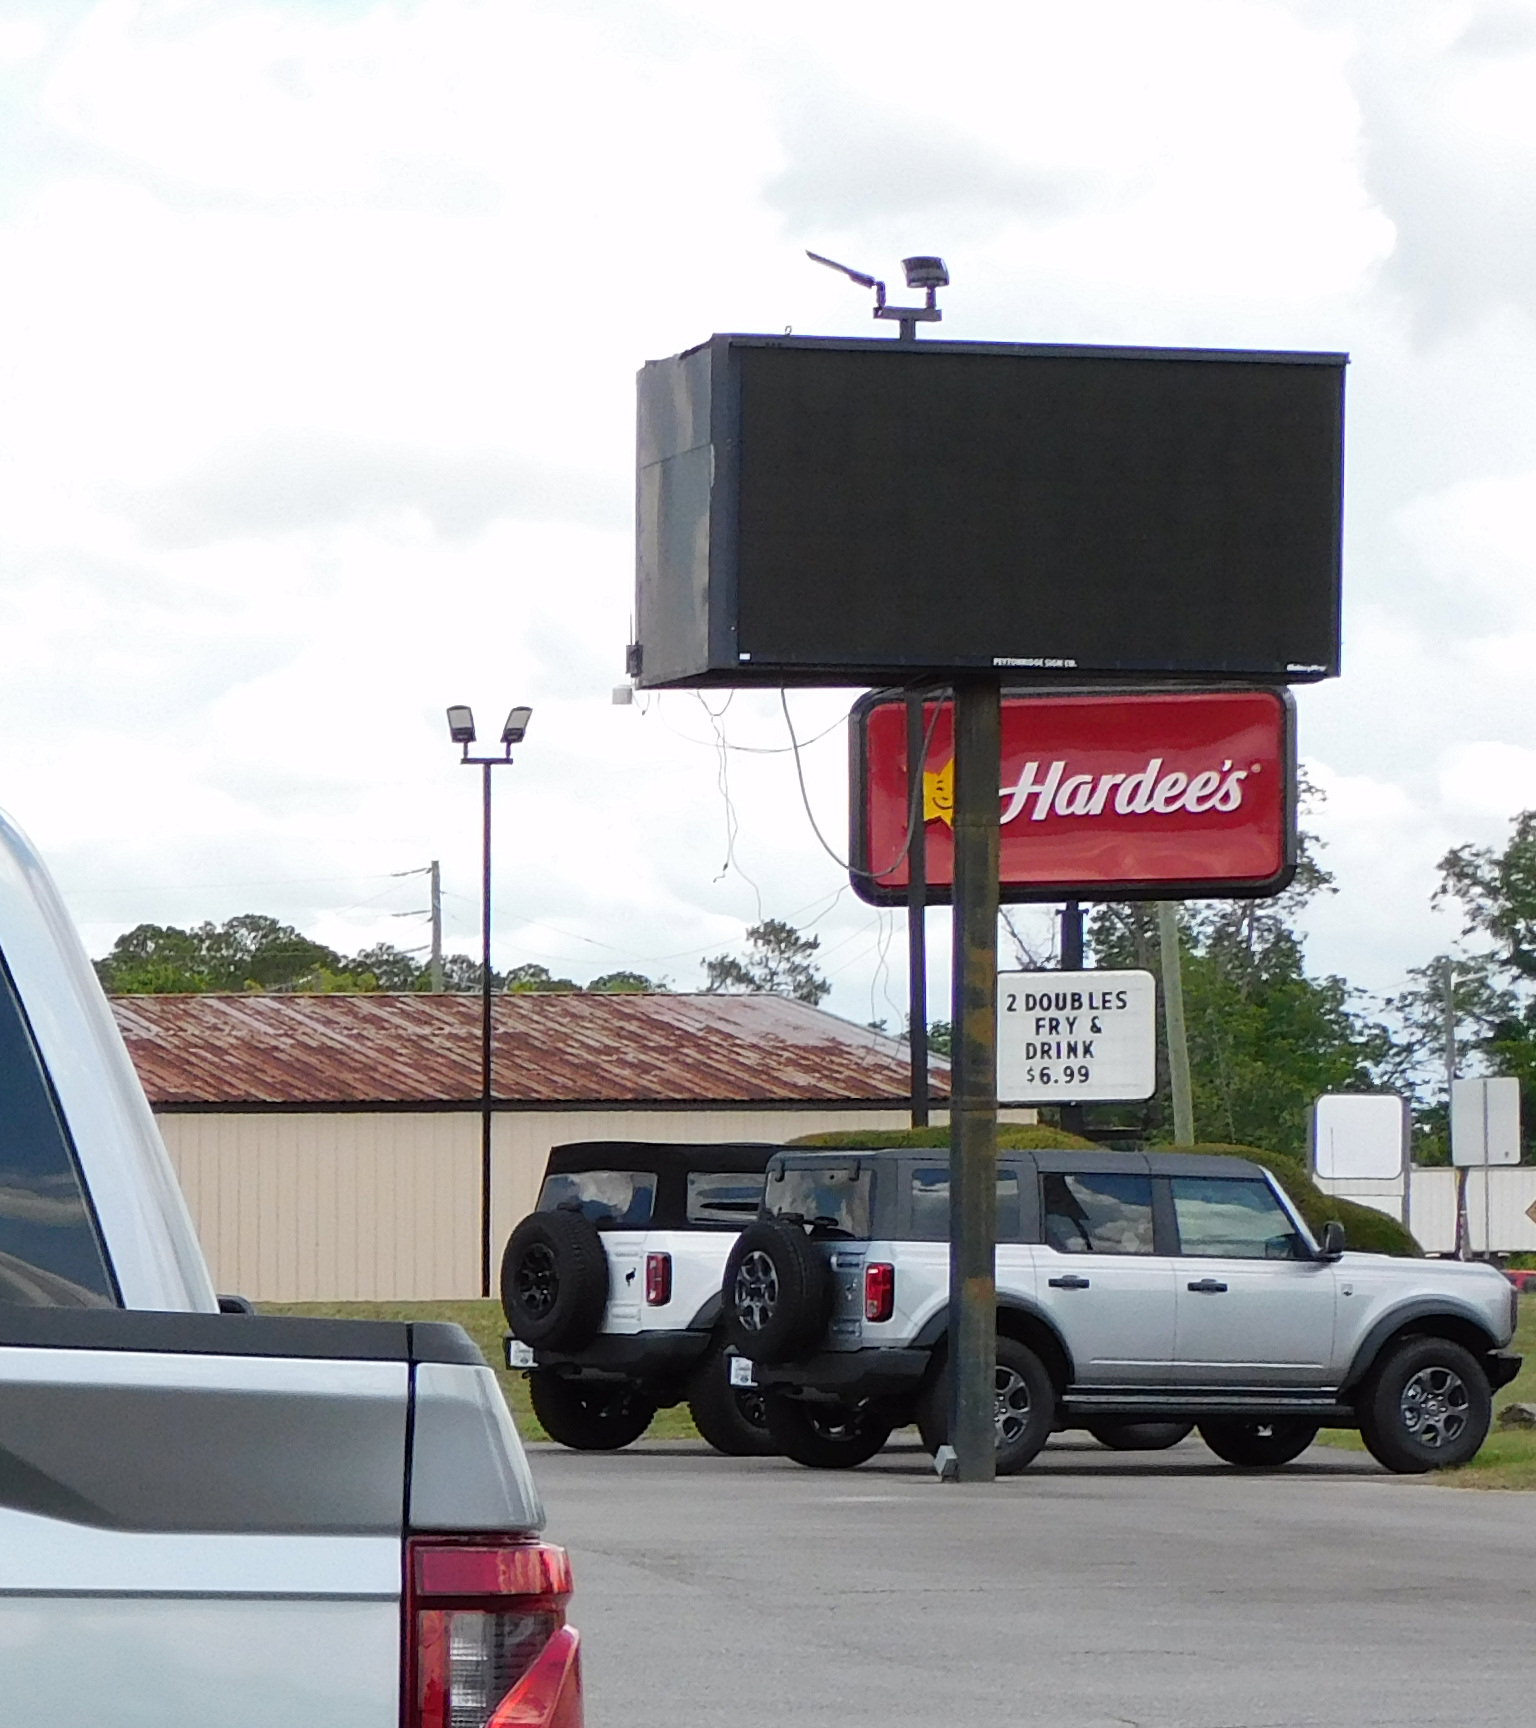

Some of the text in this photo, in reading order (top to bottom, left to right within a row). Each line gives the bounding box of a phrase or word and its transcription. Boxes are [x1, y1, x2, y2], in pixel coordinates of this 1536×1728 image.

[998, 757, 1248, 825] Hardee's
[1006, 990, 1128, 1012] 2 DOUBLES
[1034, 1015, 1102, 1036] FRY &
[1025, 1040, 1095, 1060] DRINK
[1026, 1065, 1090, 1085] $6.99
